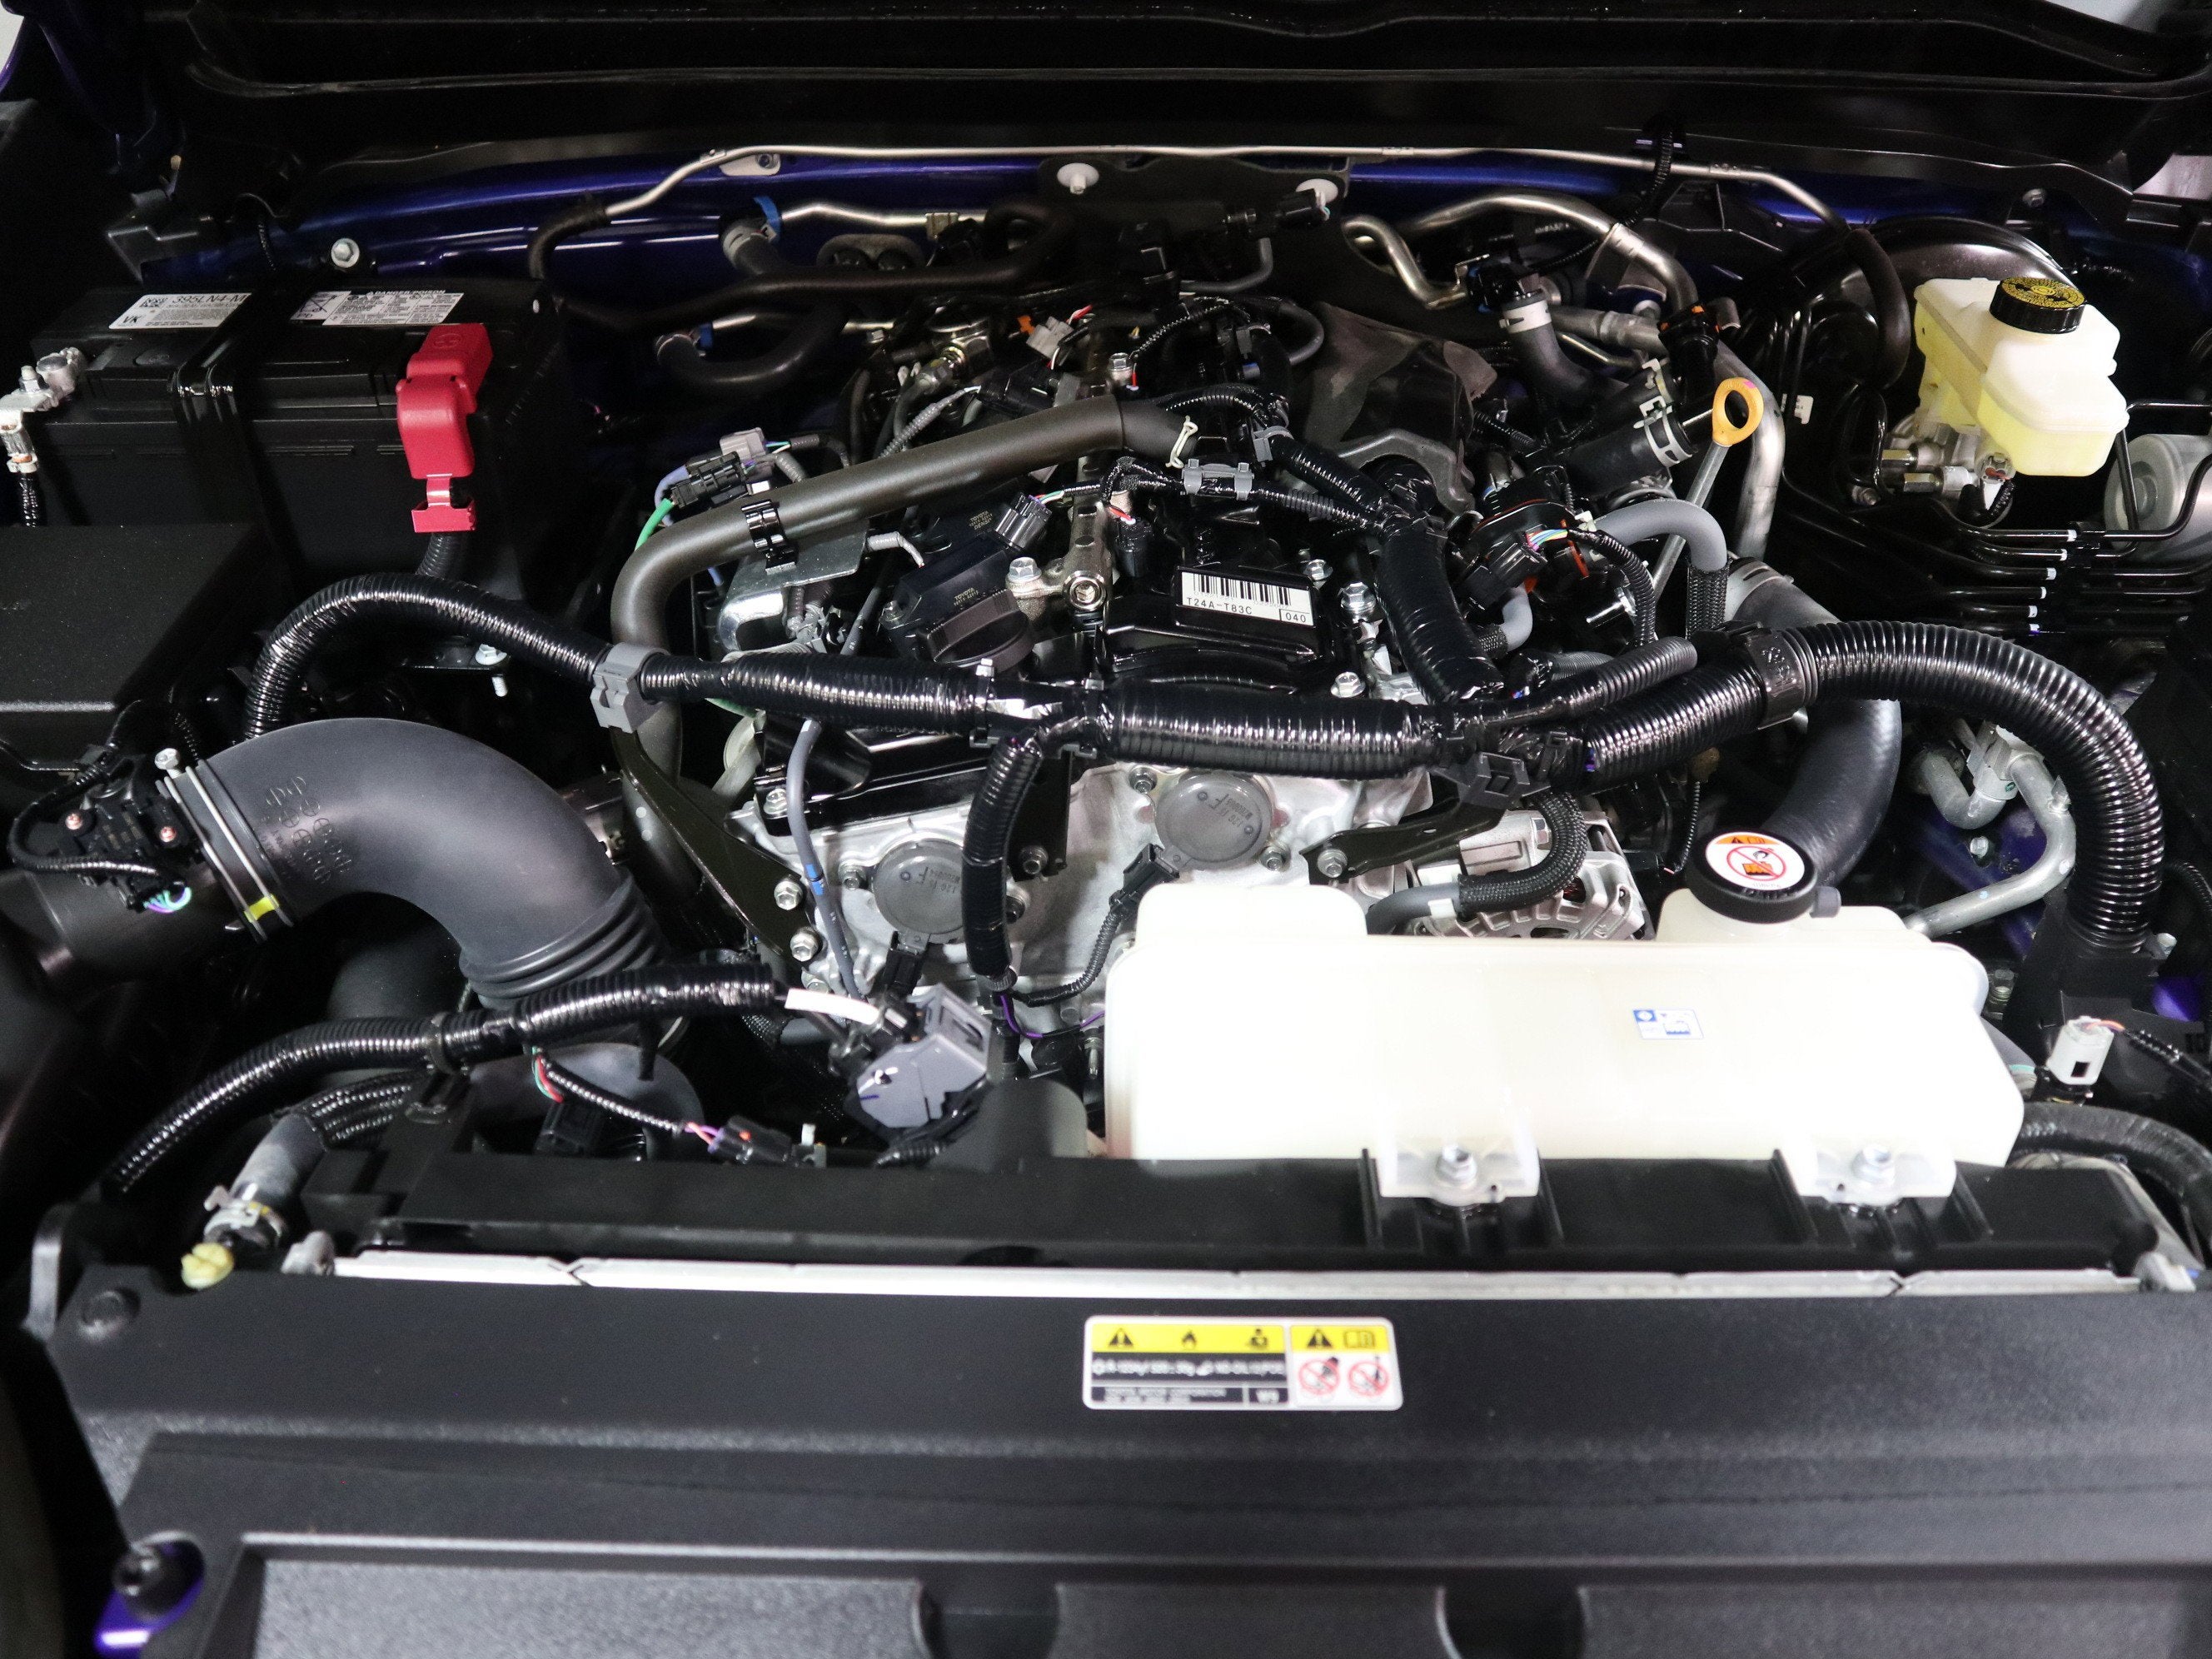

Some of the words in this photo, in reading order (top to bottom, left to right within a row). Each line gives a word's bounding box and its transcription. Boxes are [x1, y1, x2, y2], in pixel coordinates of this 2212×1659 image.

[969, 511, 989, 522] TOYOTA
[954, 587, 975, 601] TOYOTA
[1187, 597, 1253, 615] T24A-T83C
[1285, 612, 1307, 623] 040
